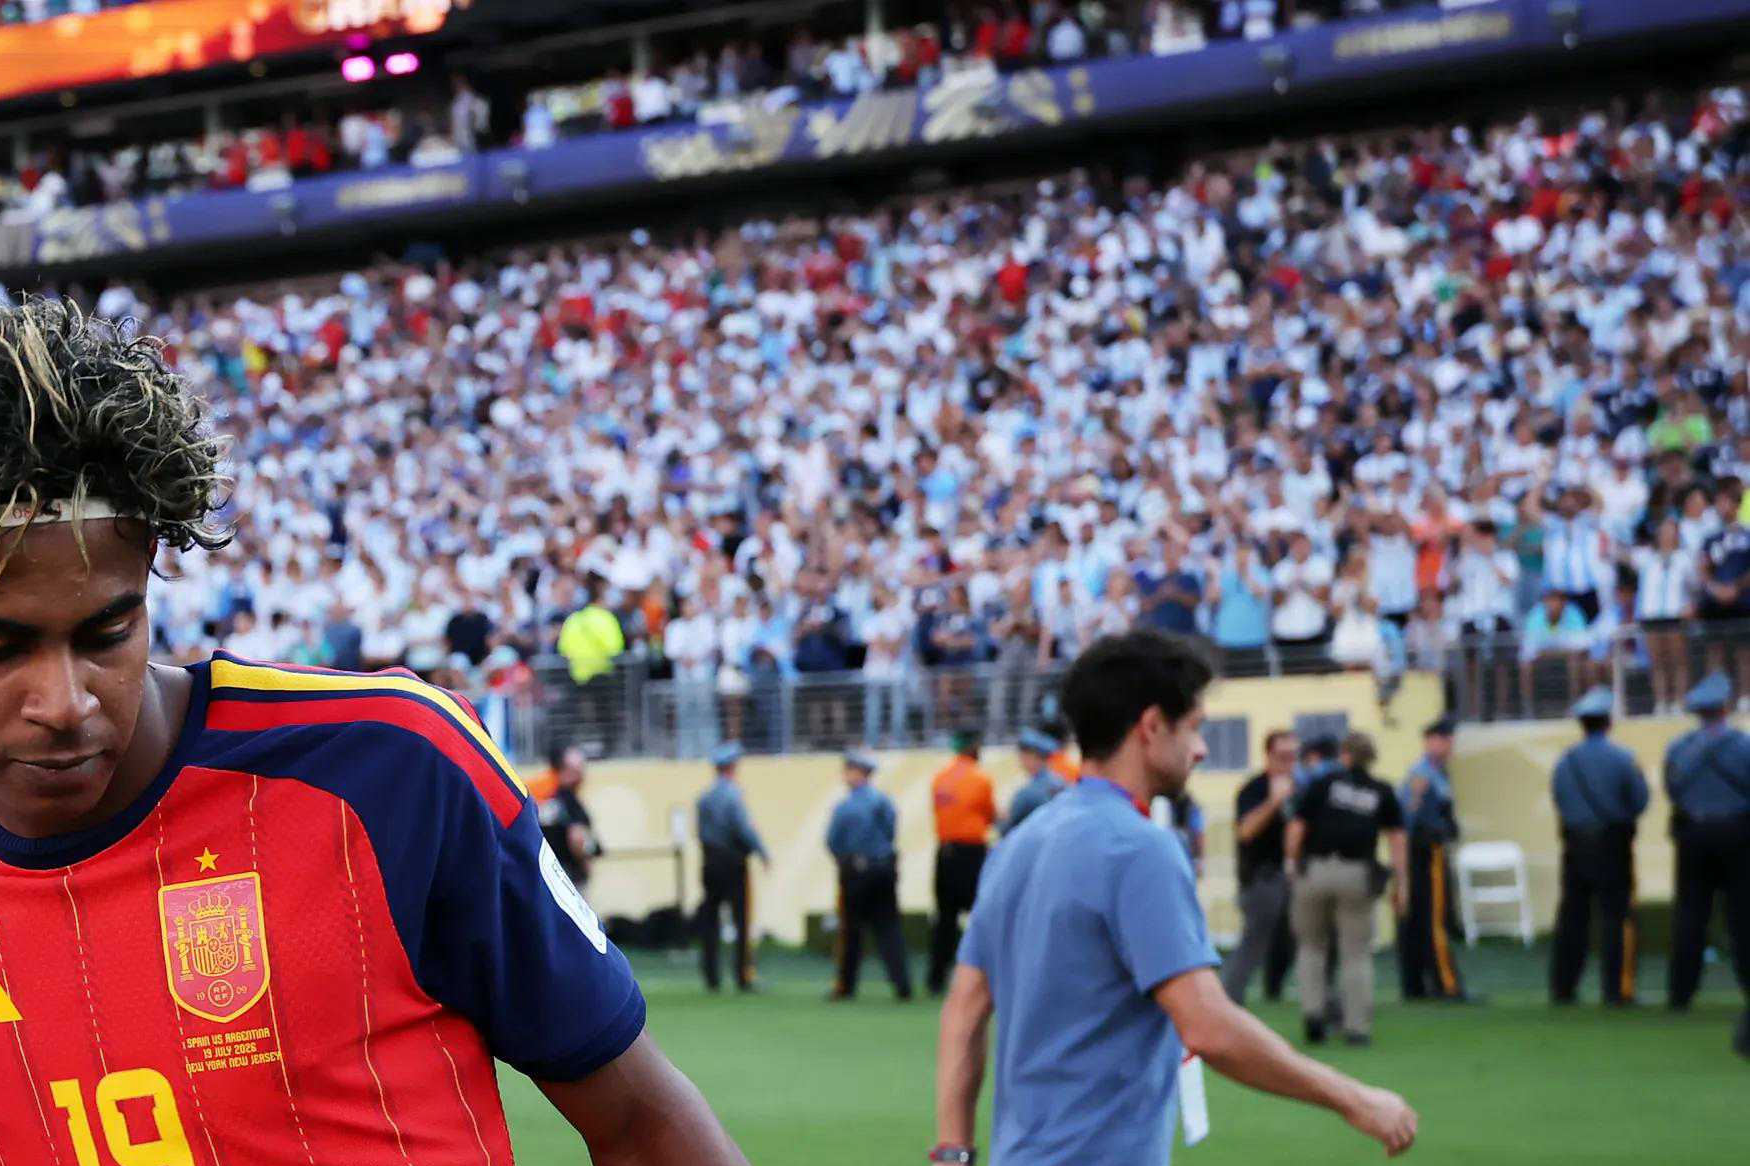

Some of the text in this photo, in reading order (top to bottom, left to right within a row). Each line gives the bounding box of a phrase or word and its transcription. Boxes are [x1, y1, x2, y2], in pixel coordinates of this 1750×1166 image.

[186, 1036, 210, 1049] SPAIN
[225, 1027, 270, 1043] ARGENTINA
[203, 1042, 257, 1059] 19 JULY 2026
[185, 1051, 282, 1073] NEW YORK NEW JERSEY
